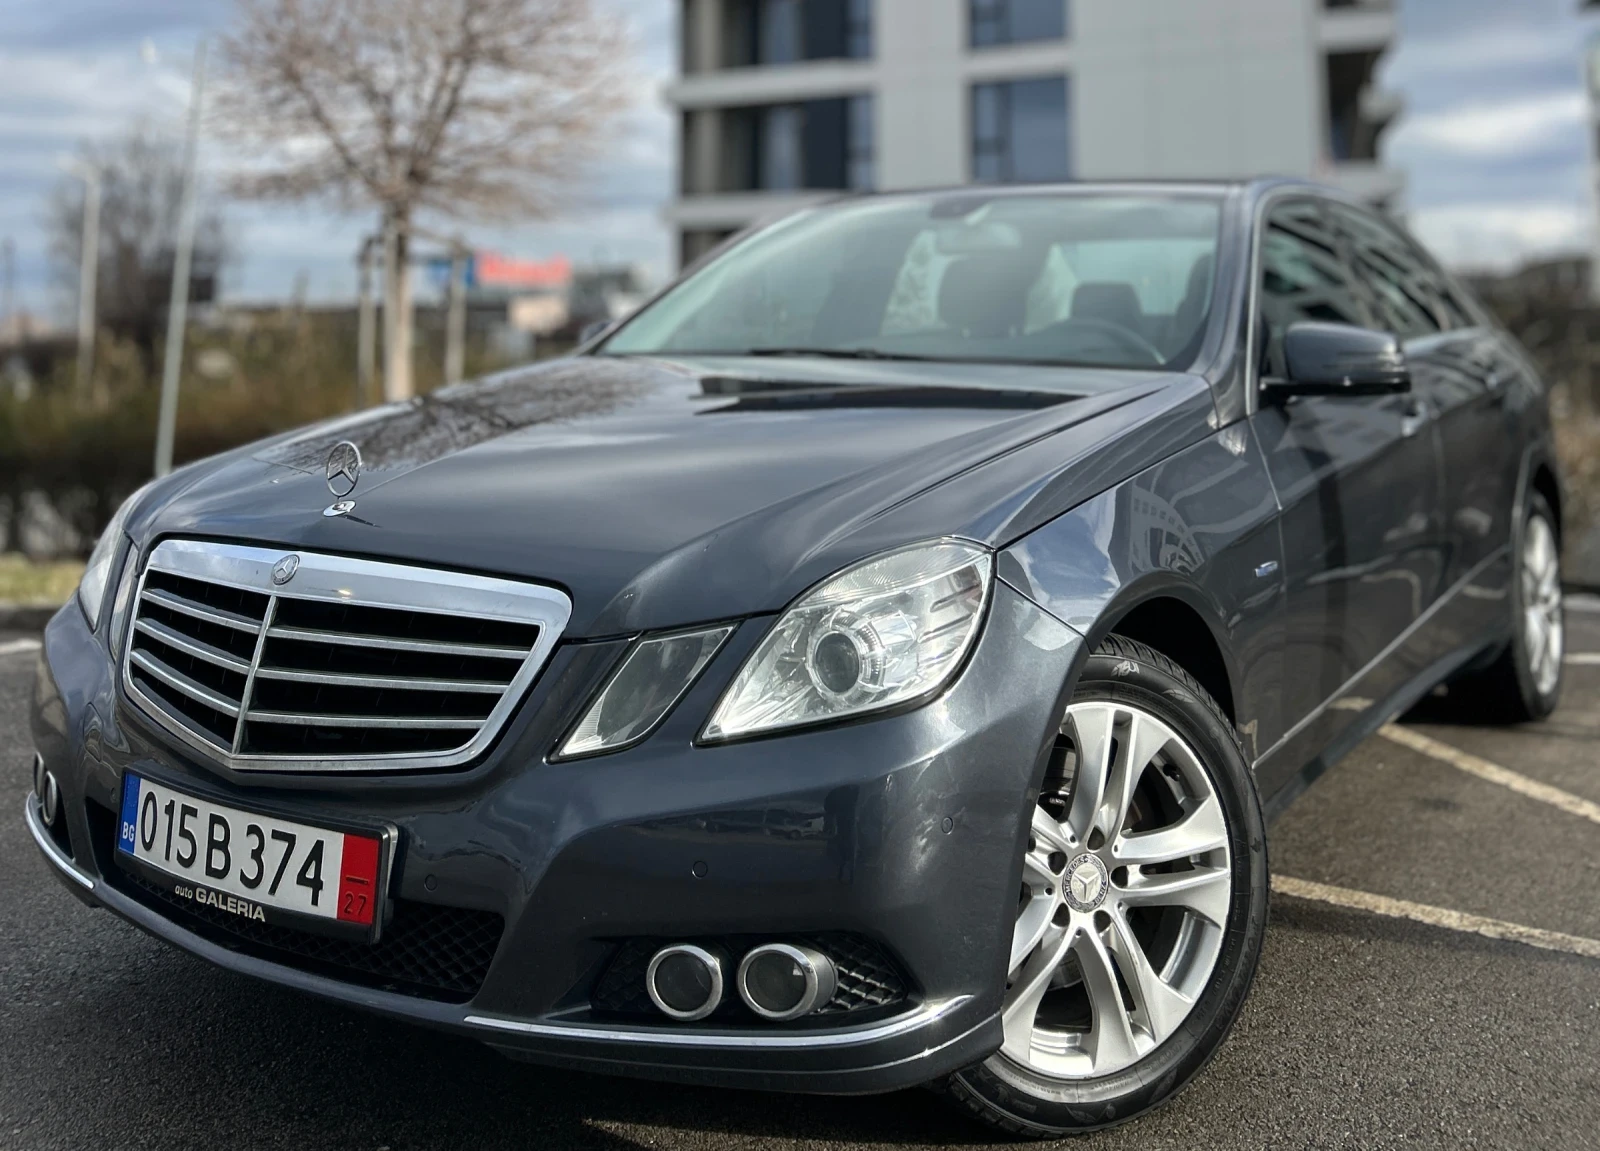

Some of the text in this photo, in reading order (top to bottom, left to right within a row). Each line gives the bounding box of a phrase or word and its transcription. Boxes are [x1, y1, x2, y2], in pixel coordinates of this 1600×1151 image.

[123, 821, 135, 843] BG
[174, 885, 266, 922] auto GALERIA
[344, 891, 368, 916] 27
